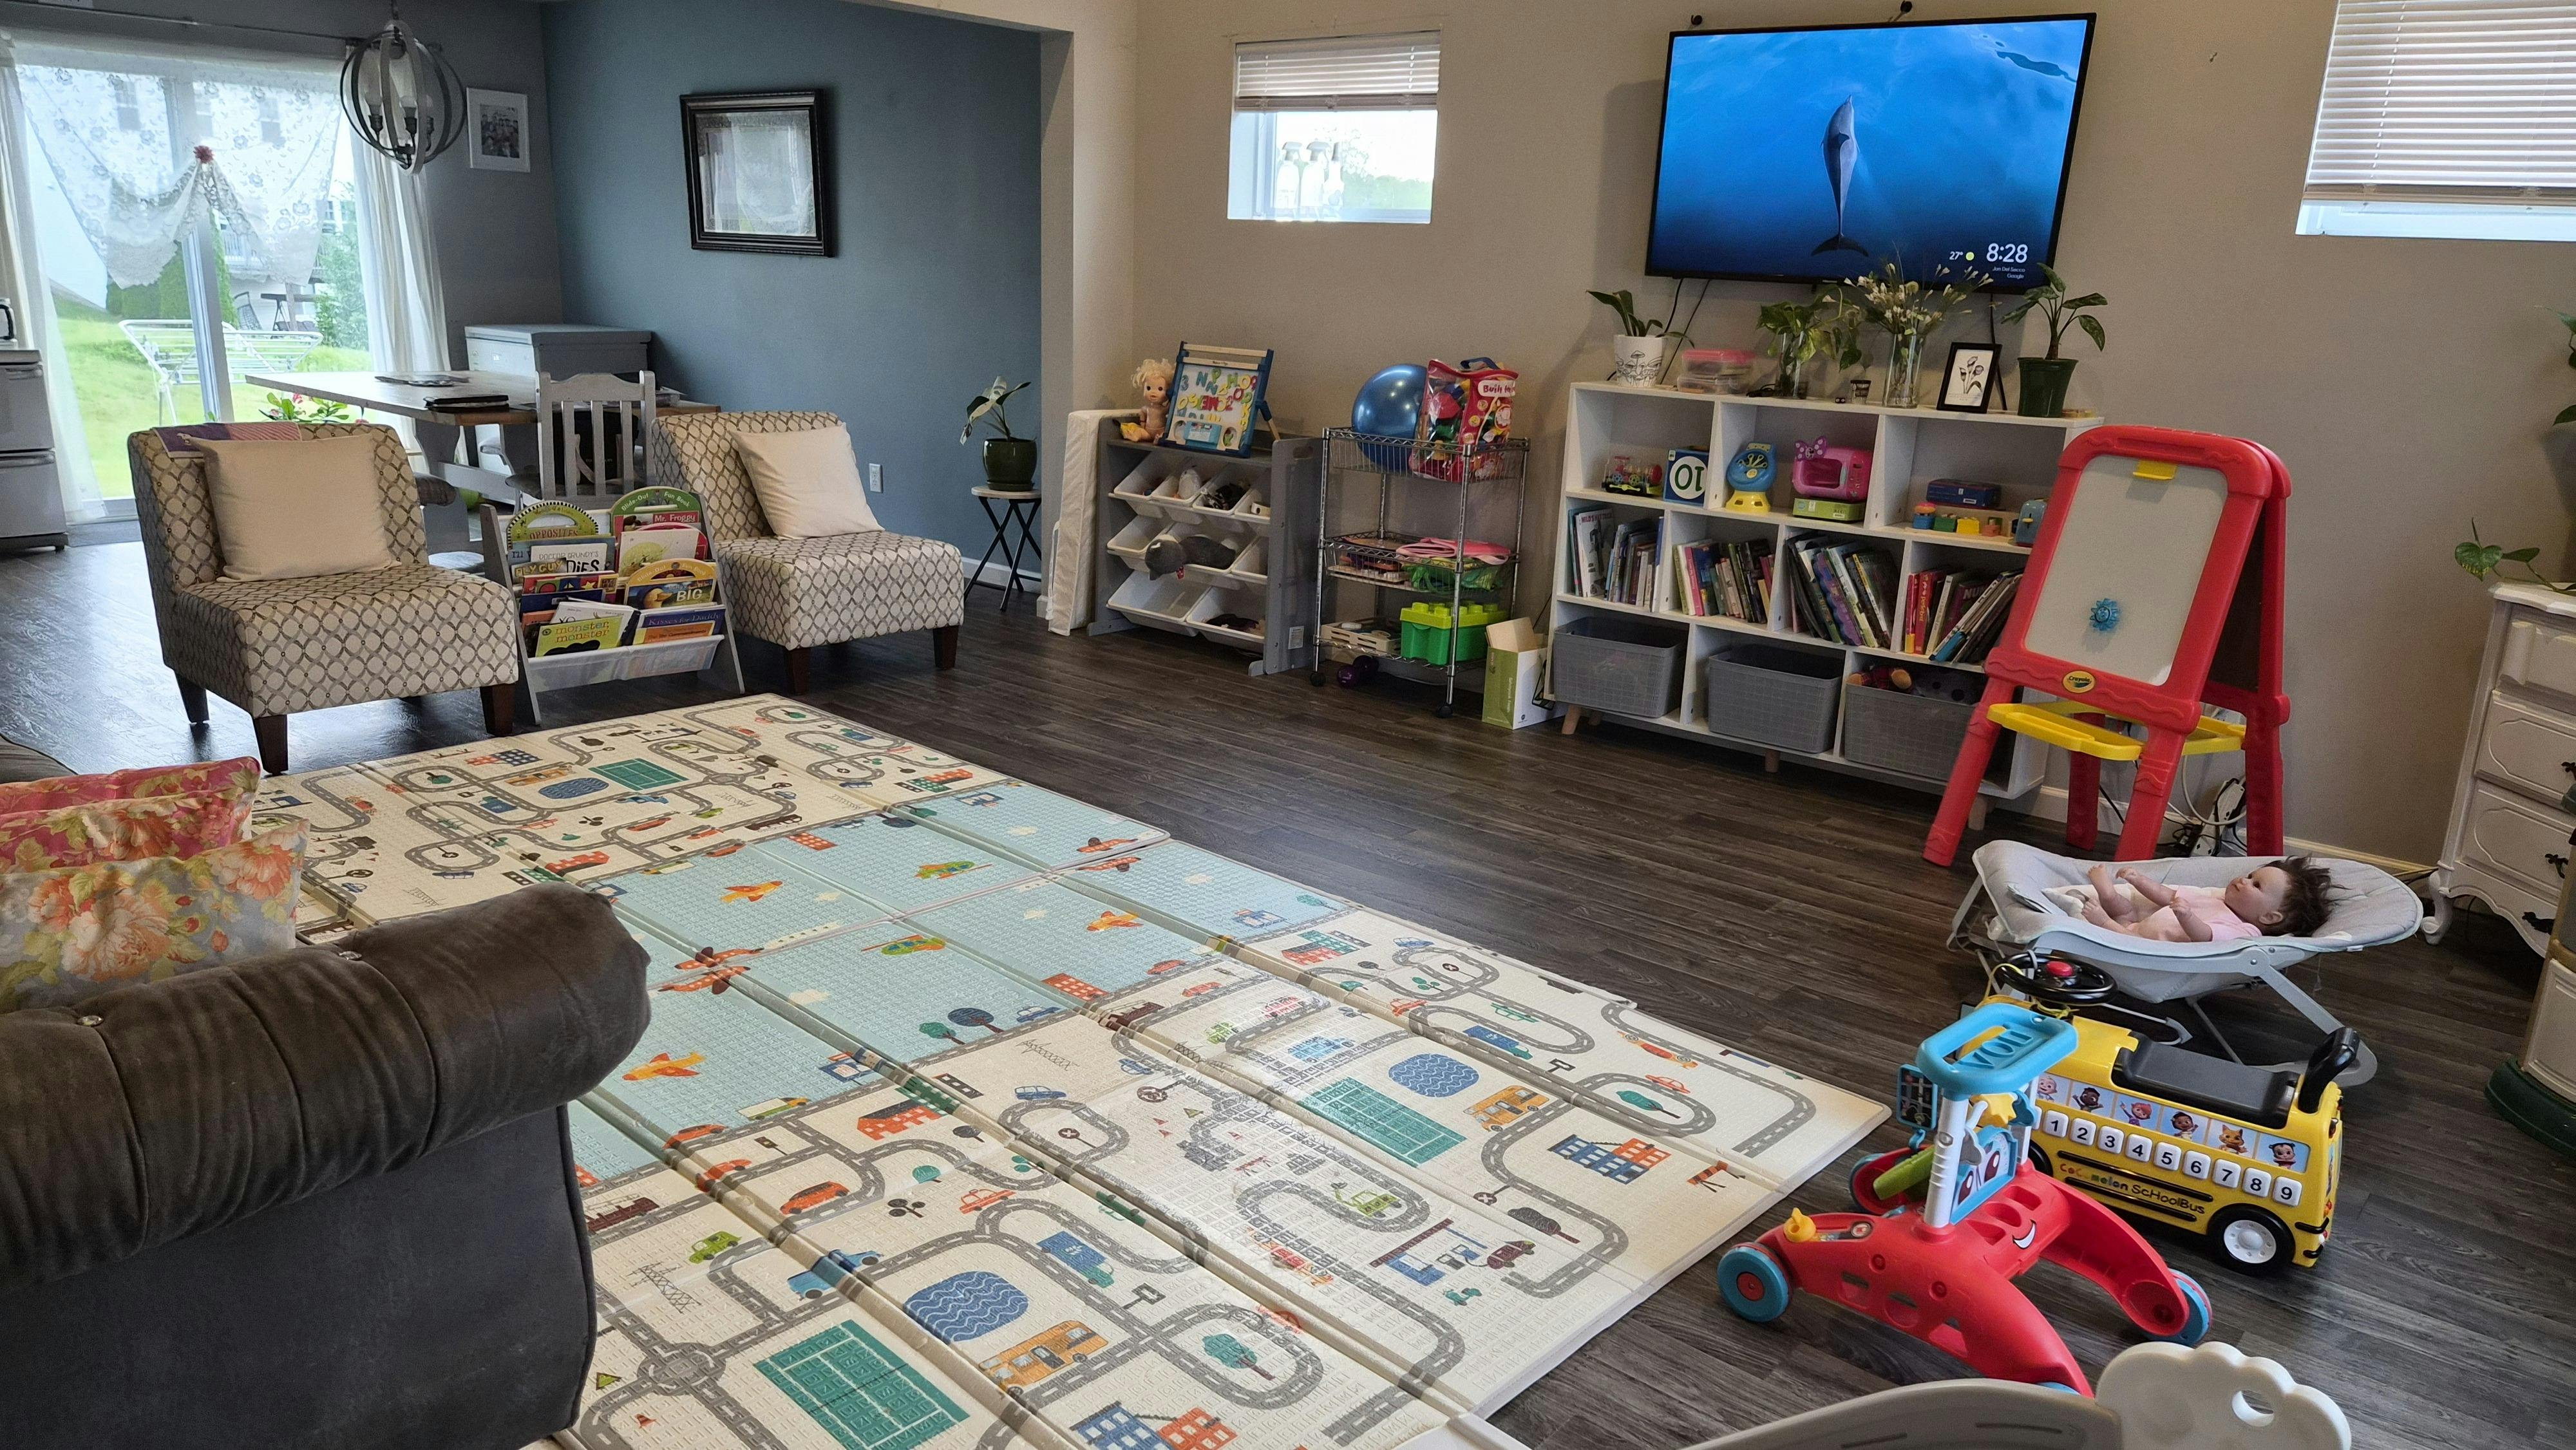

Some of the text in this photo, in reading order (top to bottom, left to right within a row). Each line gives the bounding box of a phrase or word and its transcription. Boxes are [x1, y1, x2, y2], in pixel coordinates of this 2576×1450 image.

[1949, 250, 1964, 260] 27°
[1986, 242, 2029, 263] 8:28
[1483, 384, 1502, 393] Built
[664, 491, 675, 500] Fun
[676, 495, 690, 507] Book
[669, 514, 696, 523] Froggy
[529, 529, 578, 540] OPPOSITES
[567, 551, 599, 559] GRUNDY'S
[538, 560, 563, 572] GUY
[676, 588, 703, 602] BIG
[649, 617, 677, 626] Kisses
[691, 612, 719, 621] Daddy
[556, 621, 609, 635] monster,
[556, 628, 609, 643] monster
[2050, 1120, 2293, 1200] 1 2 3 4 5 6 7 8 9
